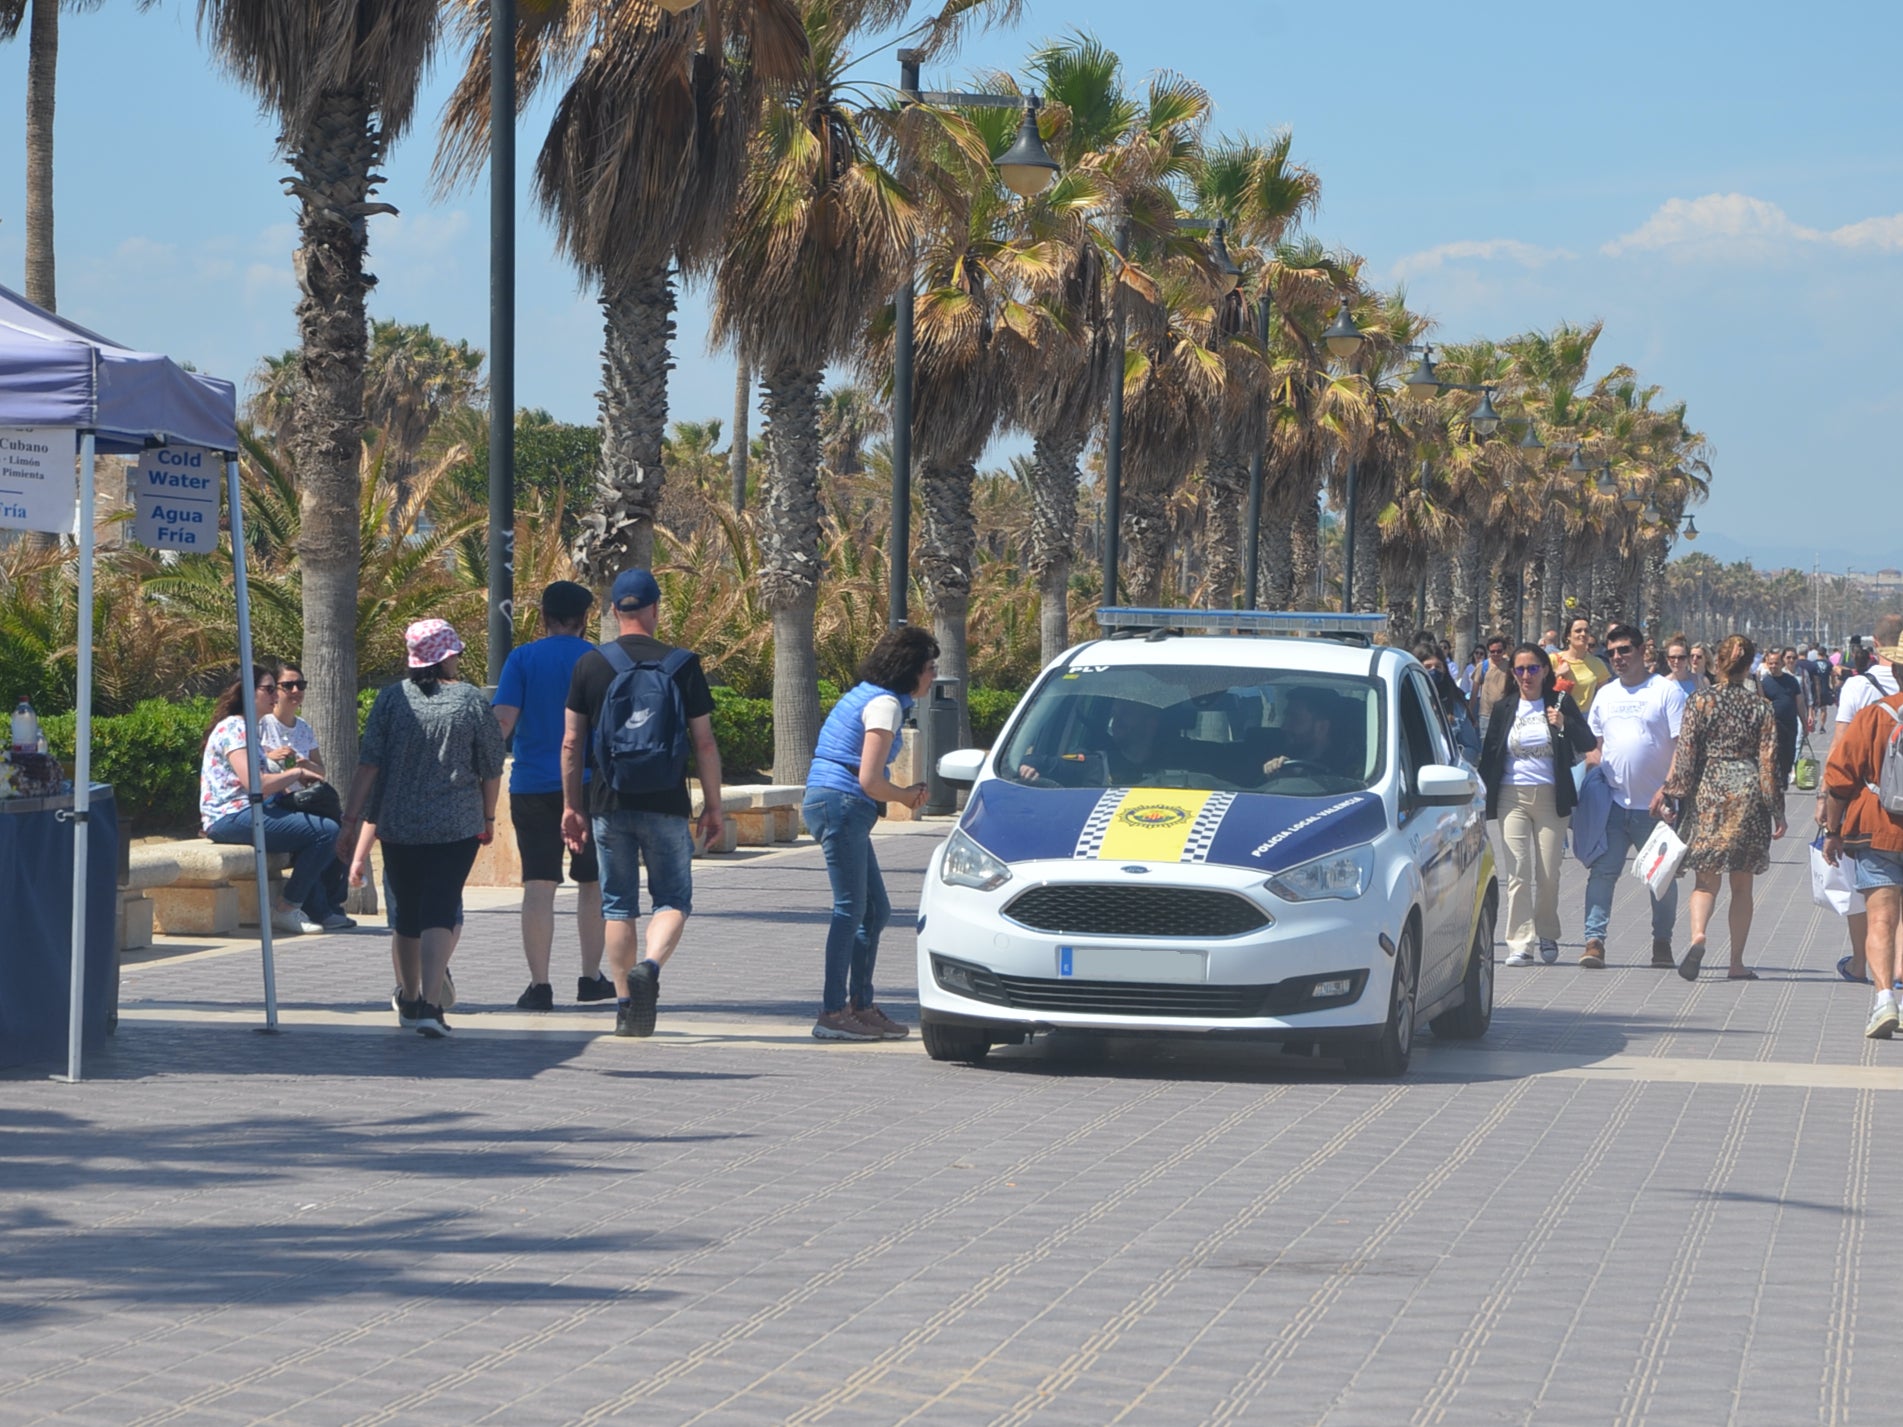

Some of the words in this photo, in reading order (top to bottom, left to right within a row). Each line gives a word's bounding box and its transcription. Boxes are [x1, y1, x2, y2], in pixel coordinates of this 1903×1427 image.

[0, 438, 49, 454] Cubano
[9, 455, 41, 467] Limón
[158, 450, 202, 468] Cold
[2, 467, 45, 480] Pimienta
[148, 470, 211, 489] Water
[151, 505, 203, 524] Agua
[158, 527, 197, 544] Fría
[1068, 665, 1110, 674] PLV
[1251, 830, 1293, 858] POLICIA
[1288, 816, 1322, 832] LOCAL
[1316, 796, 1365, 817] VALENCIA
